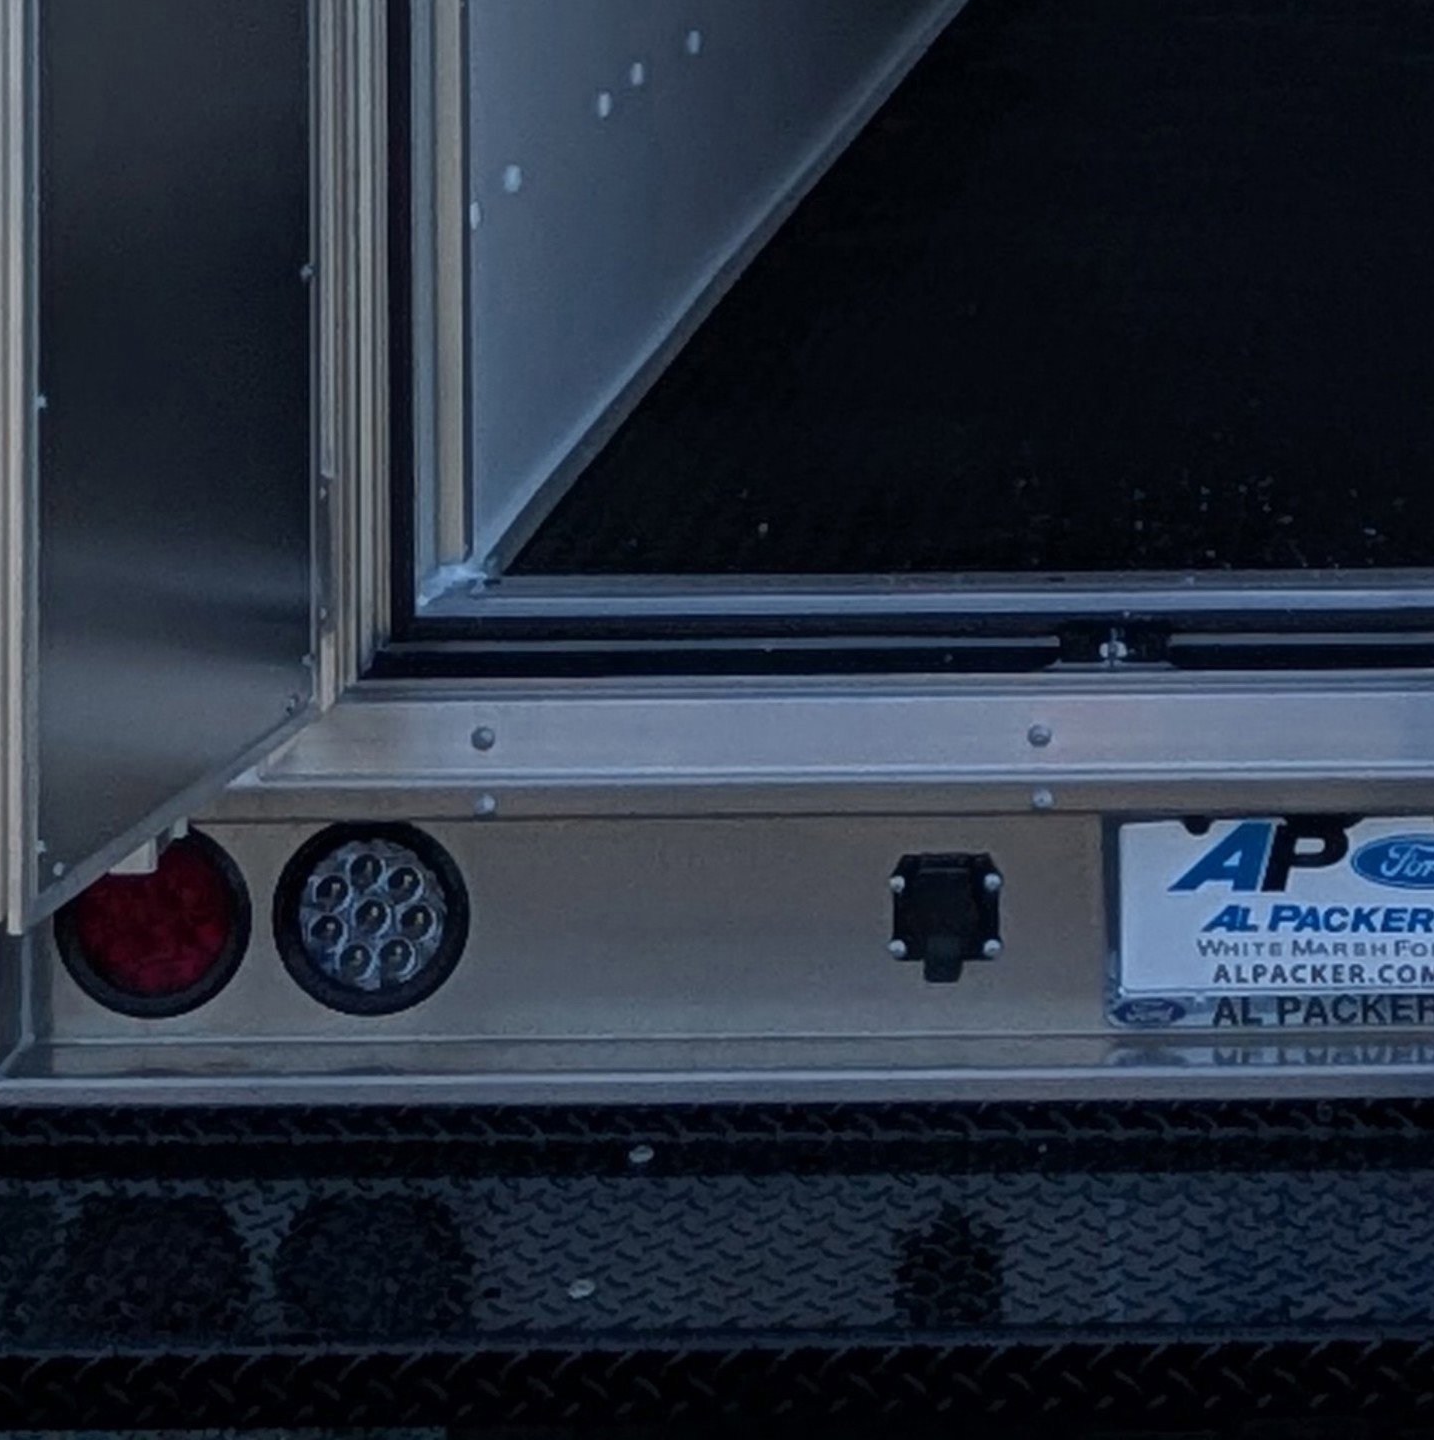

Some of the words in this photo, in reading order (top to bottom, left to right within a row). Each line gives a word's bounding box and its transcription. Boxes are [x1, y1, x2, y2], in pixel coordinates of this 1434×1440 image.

[1167, 822, 1349, 892] AP
[1201, 904, 1259, 933] AL
[1212, 996, 1263, 1026] AL
